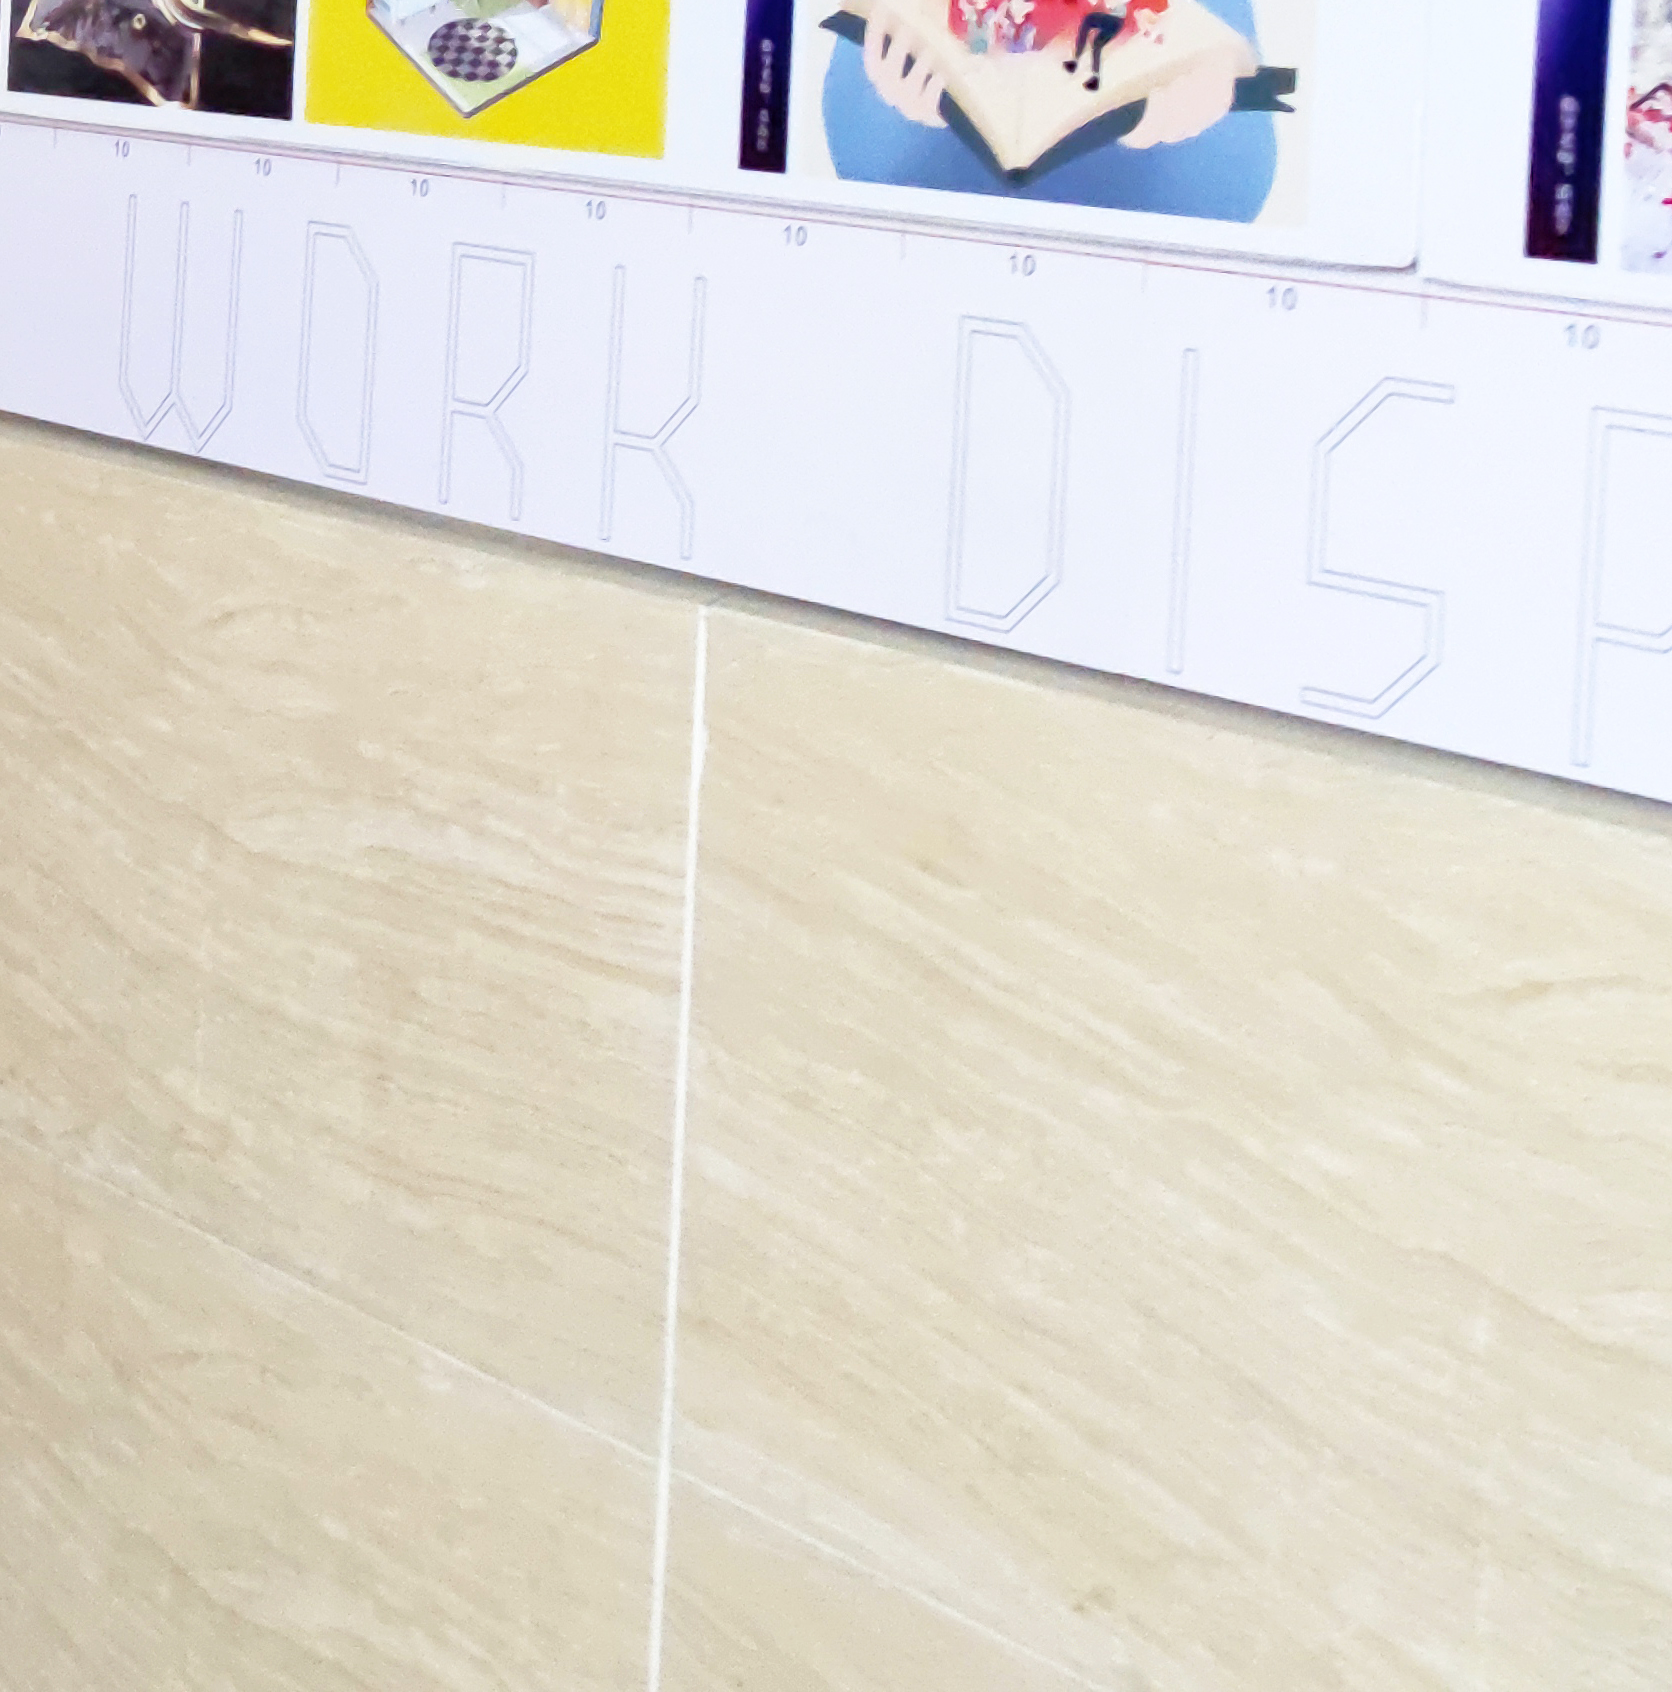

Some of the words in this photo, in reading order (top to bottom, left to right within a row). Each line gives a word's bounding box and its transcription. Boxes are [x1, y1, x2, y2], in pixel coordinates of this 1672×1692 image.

[115, 140, 130, 158] 10
[255, 158, 272, 176] 10
[411, 178, 430, 197] 10
[586, 200, 607, 220] 10
[784, 225, 808, 246] 10
[1010, 254, 1036, 276] 10
[1266, 286, 1298, 310] 10
[1564, 323, 1601, 350] 10
[118, 193, 707, 560] WORK
